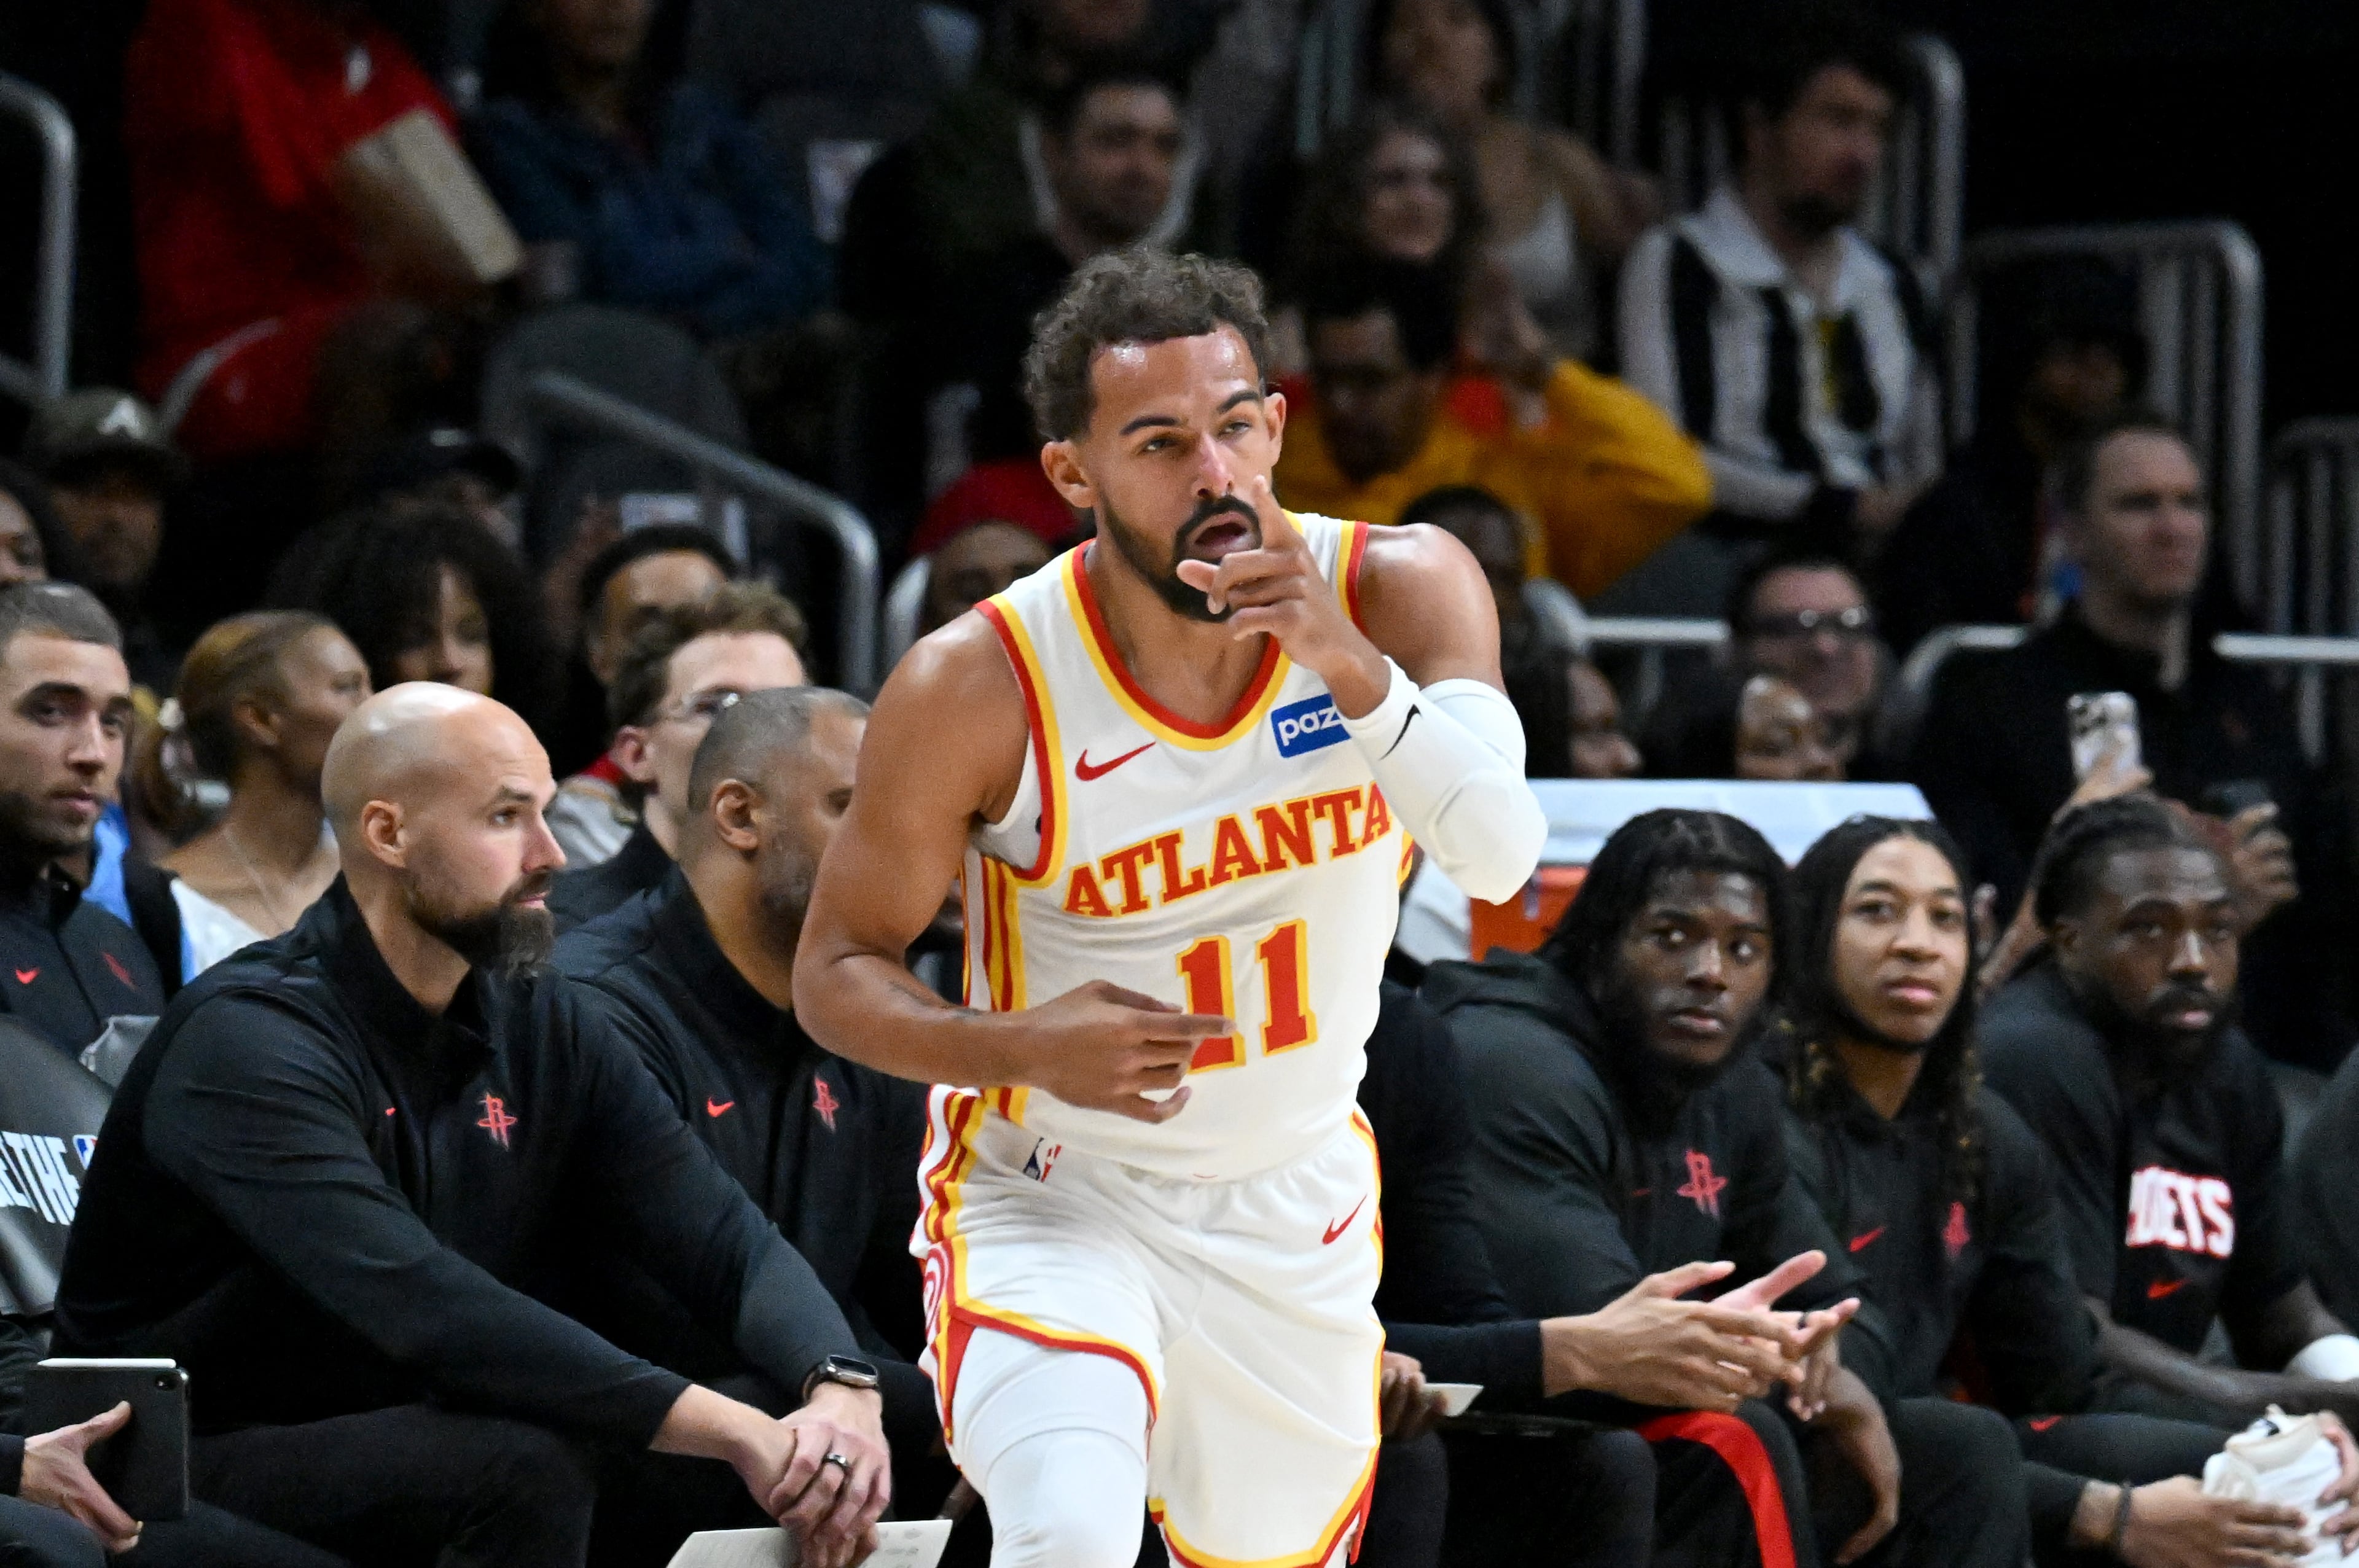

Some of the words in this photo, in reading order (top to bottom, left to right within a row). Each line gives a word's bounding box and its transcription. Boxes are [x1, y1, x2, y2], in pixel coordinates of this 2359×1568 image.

[1278, 705, 1342, 747] paz
[1063, 779, 1393, 918] ATLANTA
[1176, 918, 1318, 1074] 11
